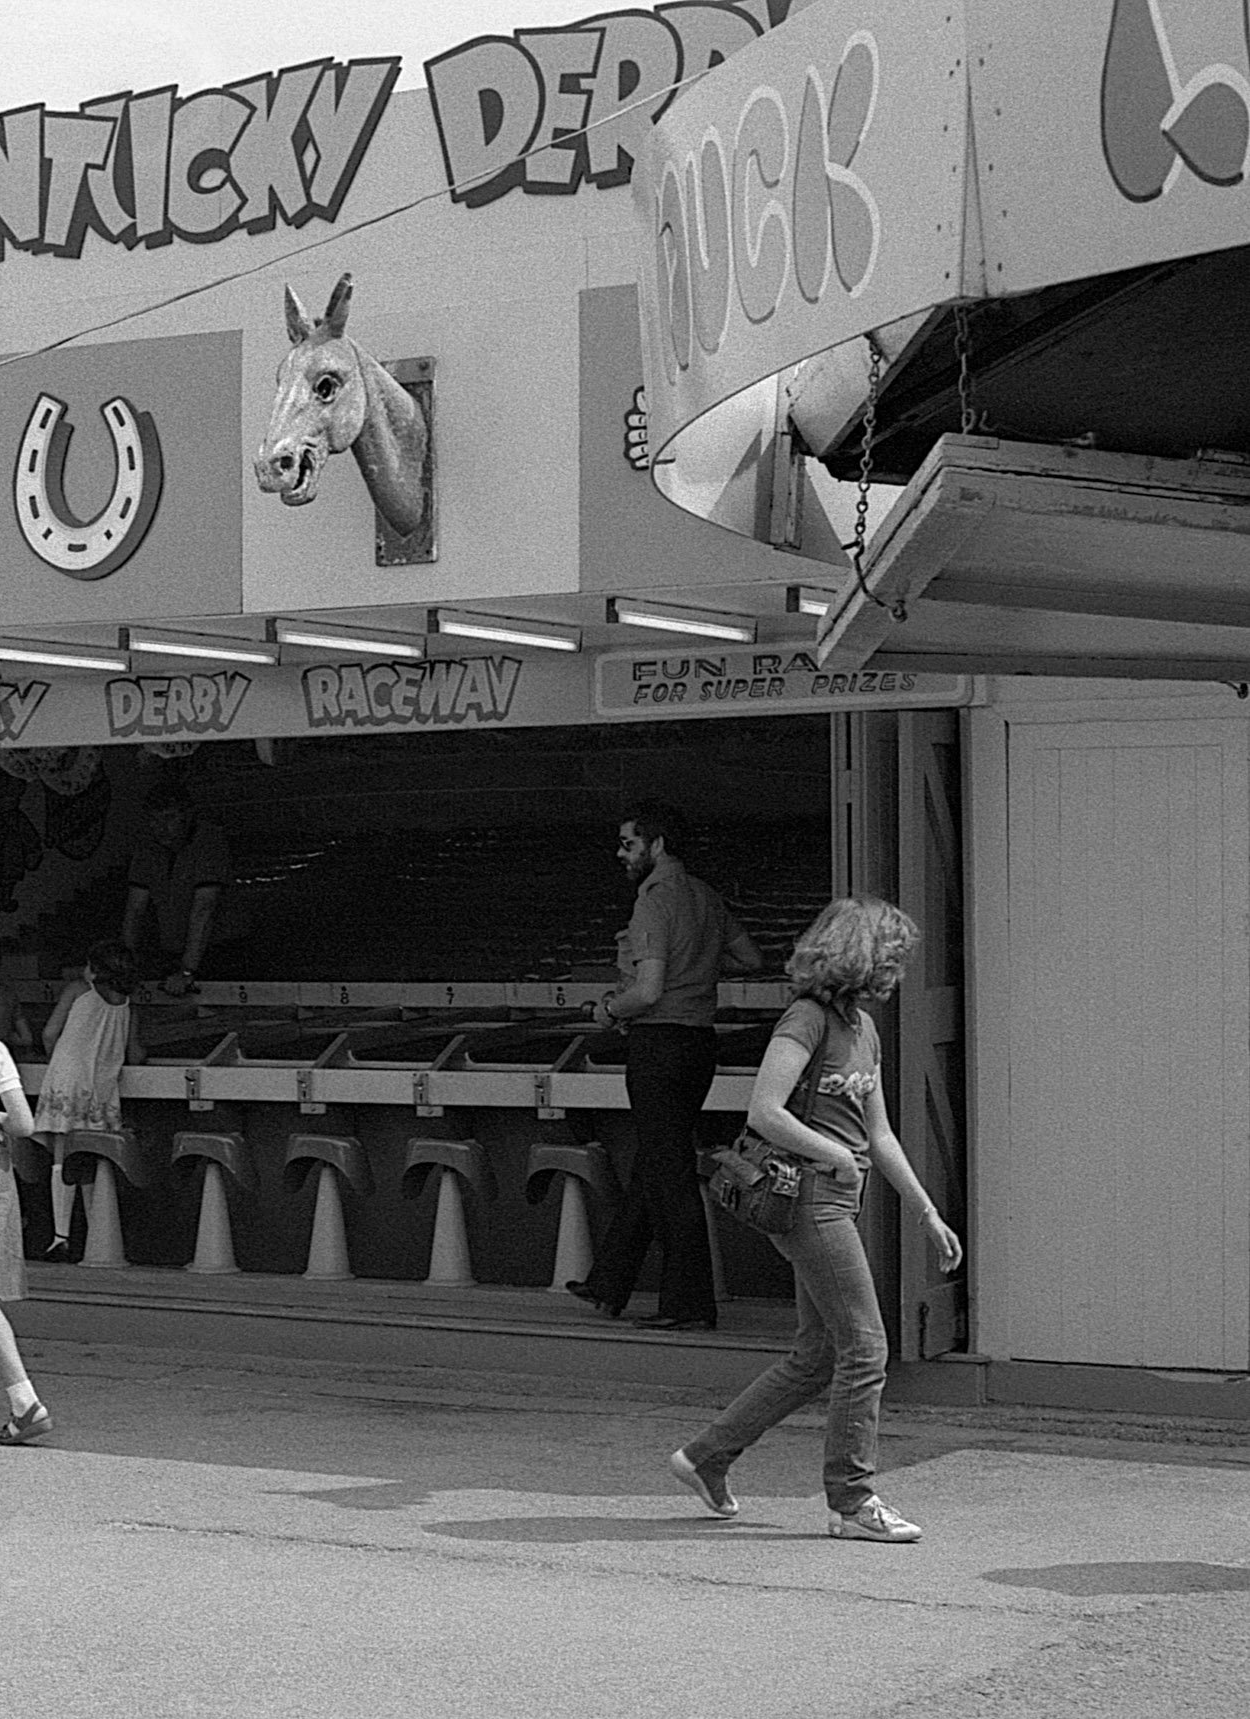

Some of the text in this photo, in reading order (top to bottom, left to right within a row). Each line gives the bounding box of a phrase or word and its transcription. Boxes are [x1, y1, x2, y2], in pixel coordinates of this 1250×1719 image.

[422, 0, 793, 209] DER
[633, 652, 822, 682] FUN RA
[633, 672, 918, 704] FOR SUPER PRIZES
[105, 671, 251, 737] DERBY
[301, 656, 522, 727] RACEWAY
